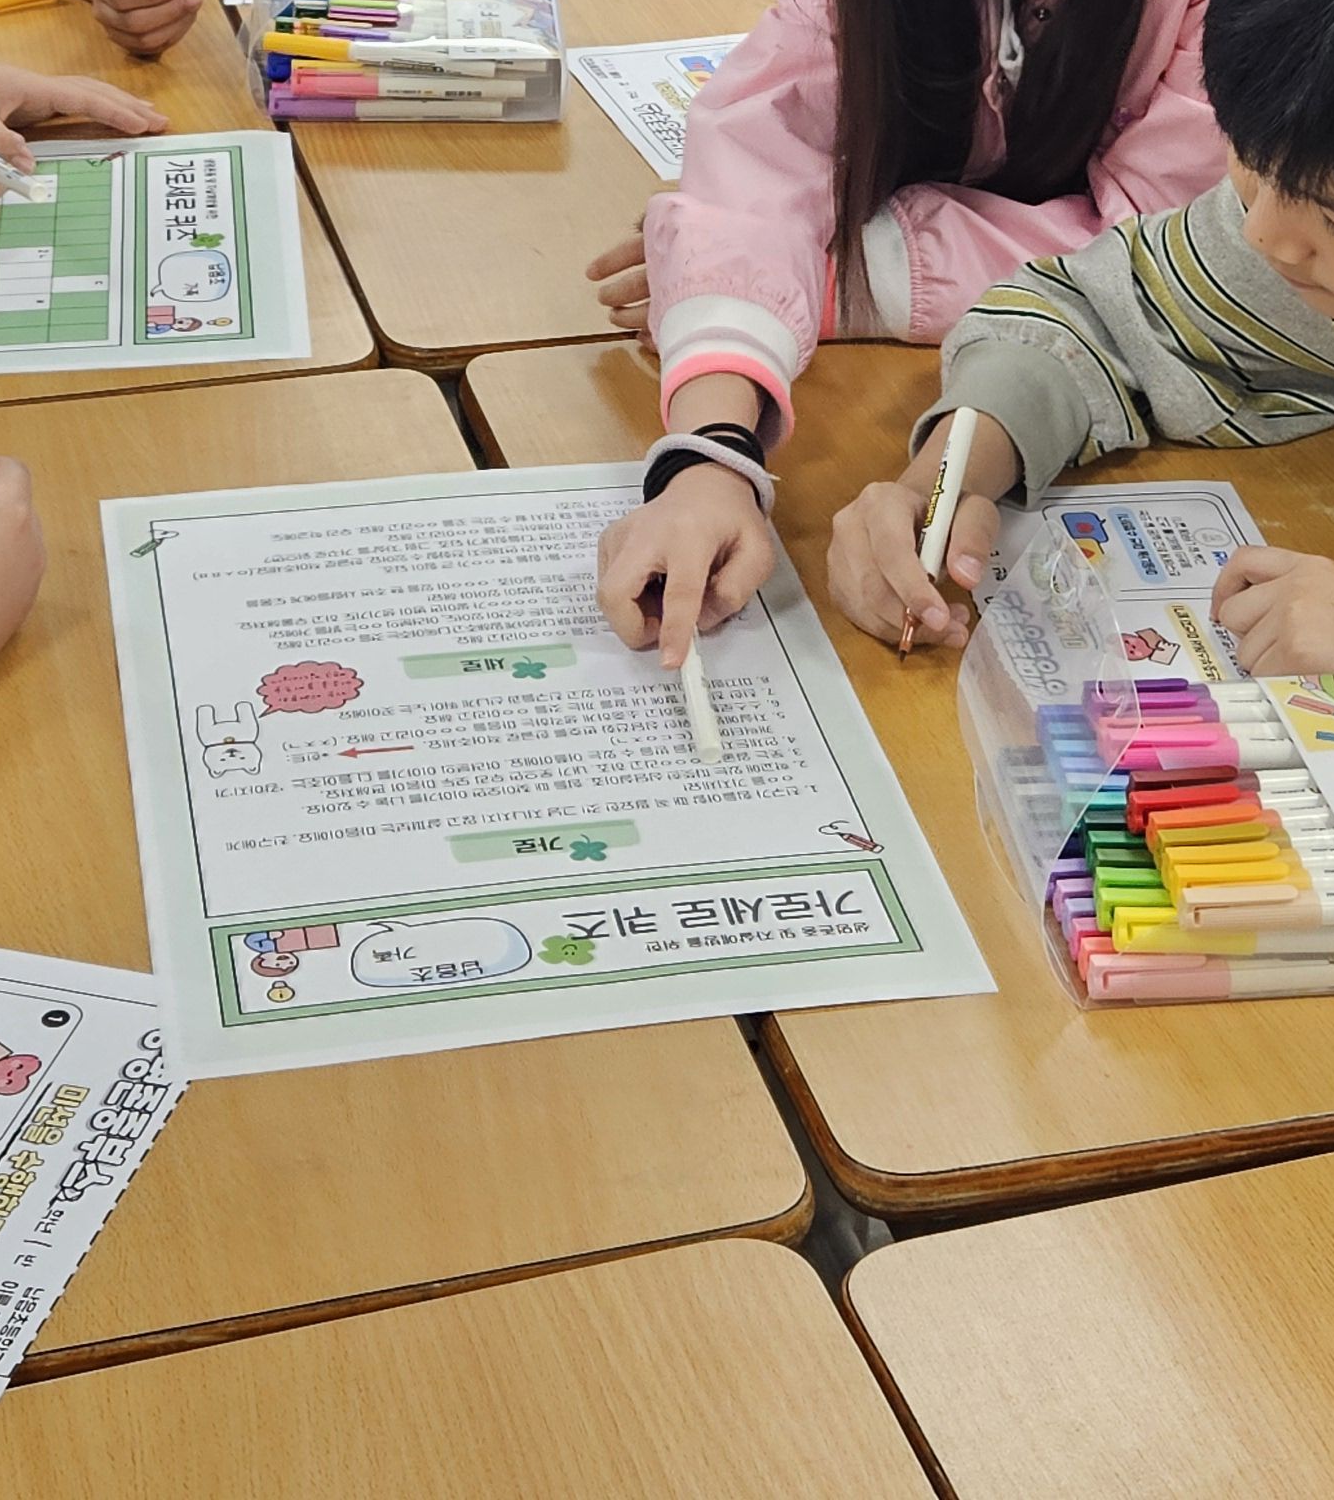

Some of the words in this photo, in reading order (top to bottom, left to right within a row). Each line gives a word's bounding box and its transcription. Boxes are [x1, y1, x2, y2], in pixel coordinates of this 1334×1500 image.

[164, 159, 196, 210] 가로세로
[165, 214, 197, 241] 퀴즈
[458, 656, 508, 674] 세로
[507, 691, 563, 704] 친구들과
[565, 689, 595, 700] 있고
[461, 696, 503, 709] 신나게
[765, 697, 780, 707] 6.
[520, 714, 578, 727] 생각하는
[771, 709, 786, 720] 5.
[472, 719, 517, 732] 마음을
[552, 725, 597, 738] 번호를
[340, 732, 376, 745] 해요.
[422, 733, 501, 750] 적어주세요.
[504, 729, 549, 742] 한글로
[781, 734, 796, 744] 4.
[719, 735, 779, 750] 언제든지
[586, 749, 617, 761] 있는
[618, 748, 635, 758] 수
[787, 746, 802, 756] 3.
[440, 760, 501, 775] 여러분의
[712, 764, 742, 776] 있는
[744, 760, 789, 773] 학교에
[792, 758, 807, 769] 2.
[355, 772, 372, 783] 다
[377, 766, 437, 781] 이야기를
[508, 768, 553, 781] 웃으면
[556, 765, 588, 777] 내가
[440, 775, 470, 788] 모두
[473, 772, 504, 784] 우리
[552, 778, 582, 790] 힘들
[681, 777, 747, 792] 가지세요!
[389, 778, 436, 792] 마음이
[534, 781, 550, 792] 때
[754, 785, 799, 798] 친구가
[803, 783, 818, 793] 1.
[407, 789, 468, 804] 이야기를
[671, 795, 689, 806] 때
[300, 800, 352, 815] 있어요.
[355, 798, 370, 810] 수
[604, 798, 650, 812] 필요한
[480, 808, 543, 824] 지나치지
[545, 805, 578, 818] 그냥
[444, 814, 478, 828] 않고
[292, 824, 376, 844] 마음이에요.
[224, 833, 288, 851] 친구에게
[510, 834, 565, 855] 가로
[669, 887, 866, 932] 가로세로
[561, 905, 662, 944] 퀴즈
[799, 918, 872, 940] 생명존중
[683, 928, 774, 952] 자살예방을
[775, 926, 797, 942] 및
[370, 945, 415, 962] 가족
[643, 938, 681, 957] 위한
[408, 959, 484, 982] 납읍초
[23, 1082, 92, 1147] 미션을
[31, 1208, 64, 1234] 학년
[11, 1253, 37, 1268] 반
